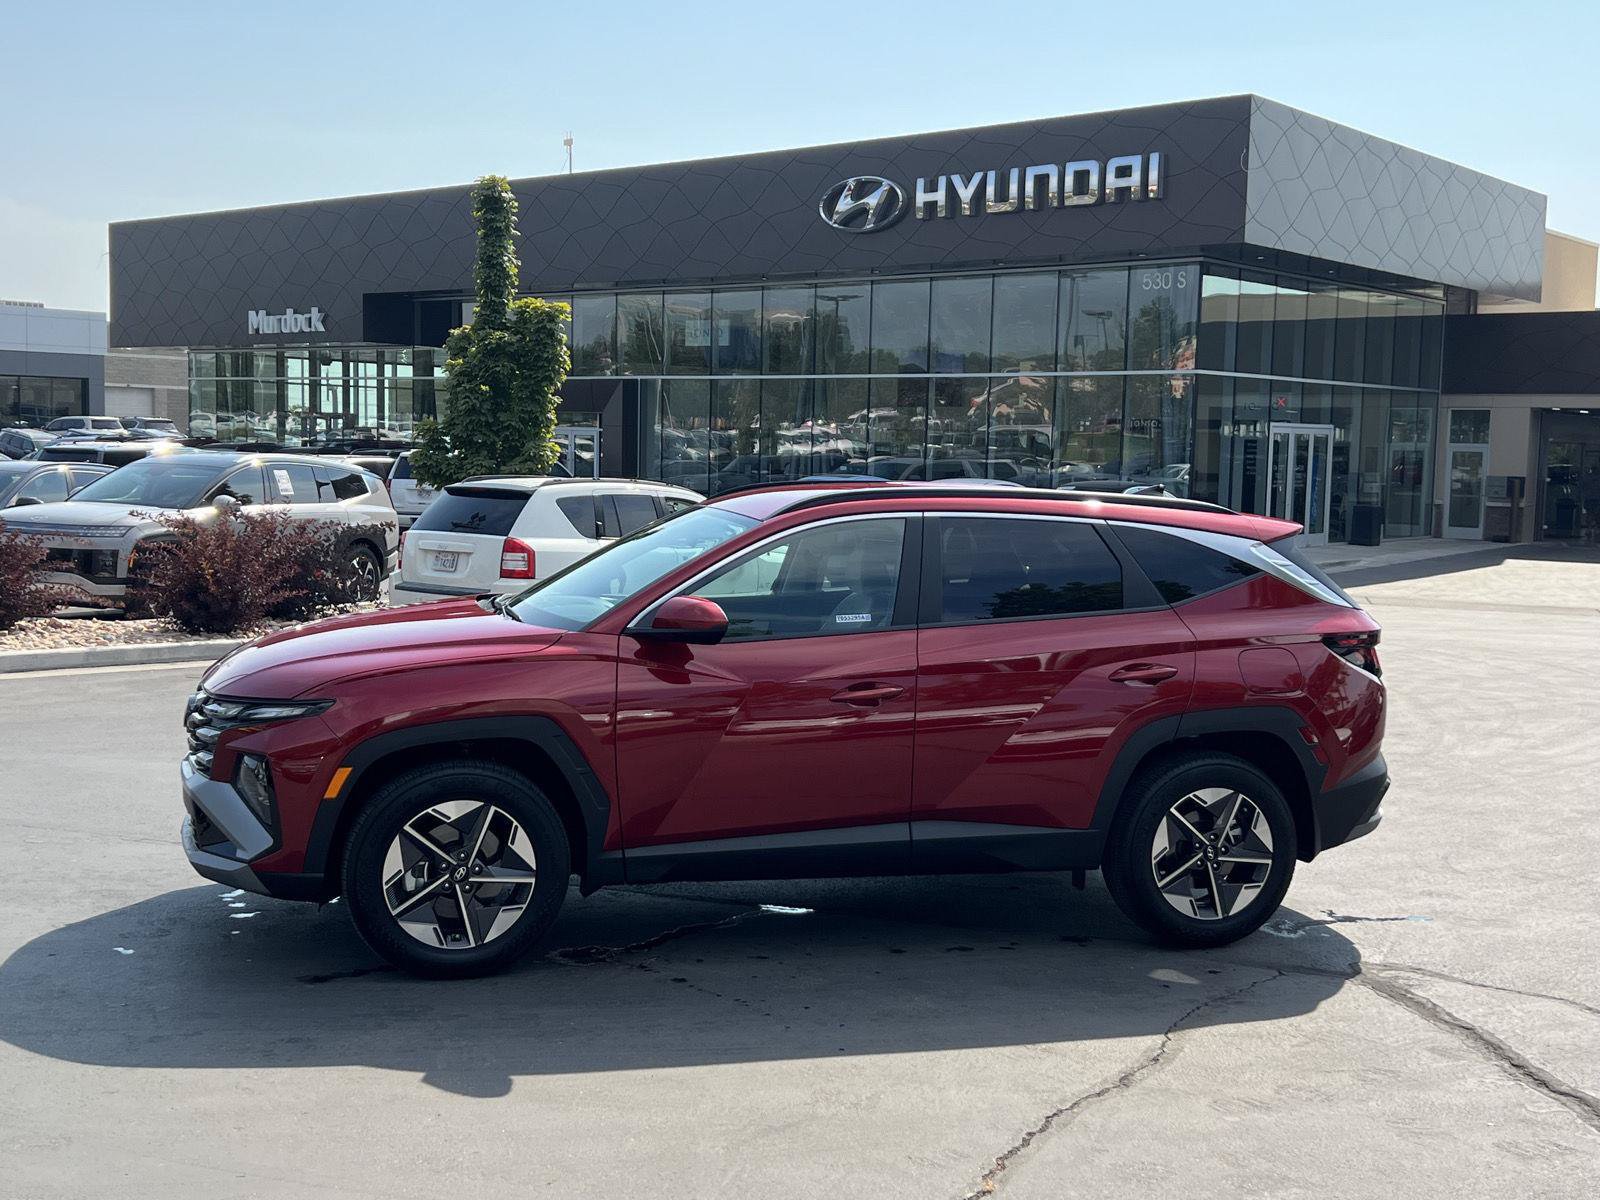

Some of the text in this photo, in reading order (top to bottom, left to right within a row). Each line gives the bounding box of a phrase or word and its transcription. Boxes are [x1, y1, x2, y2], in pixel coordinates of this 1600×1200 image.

[915, 152, 1163, 220] HYUNDAI
[1142, 271, 1187, 290] 530 S
[248, 306, 326, 335] Murdock
